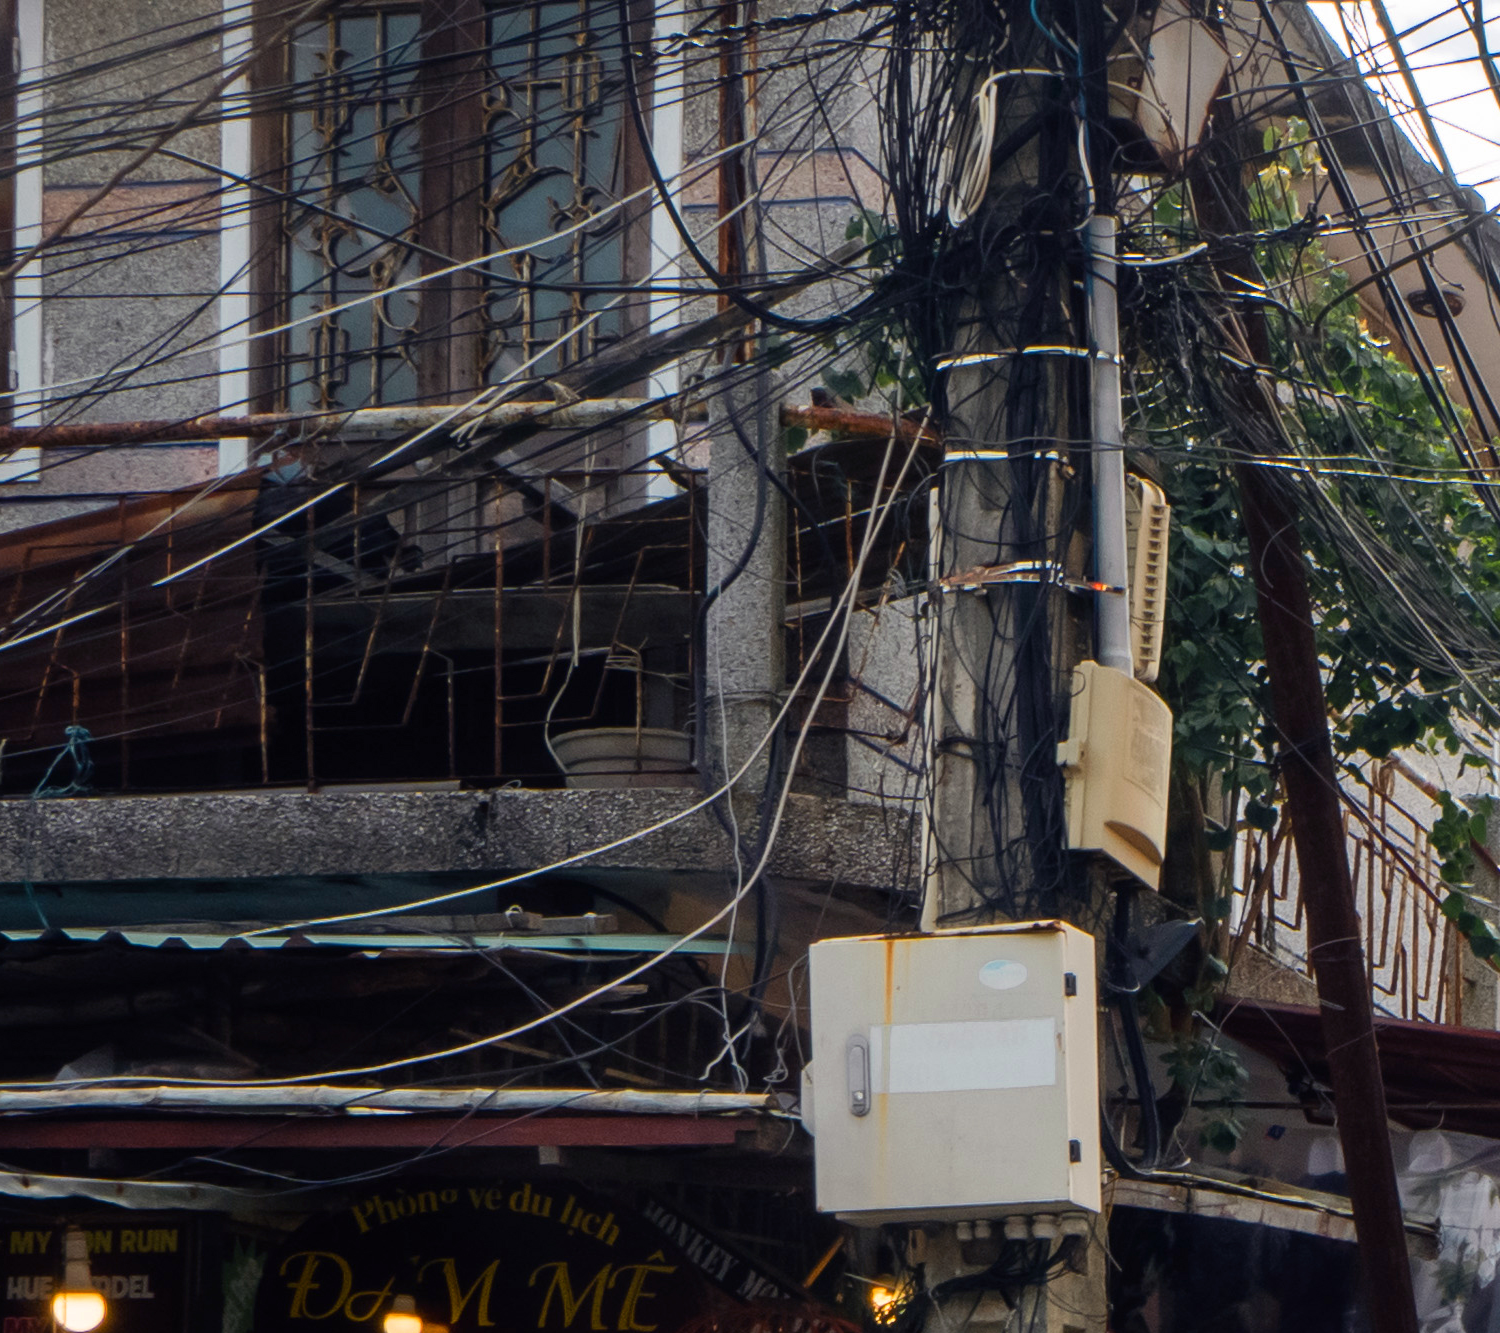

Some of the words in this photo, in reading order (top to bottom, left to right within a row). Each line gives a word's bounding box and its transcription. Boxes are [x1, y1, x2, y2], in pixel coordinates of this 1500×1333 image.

[119, 1228, 179, 1255] RUIN
[508, 1182, 554, 1219] du
[558, 1194, 622, 1247] lịch
[643, 1200, 741, 1284] MONKEY
